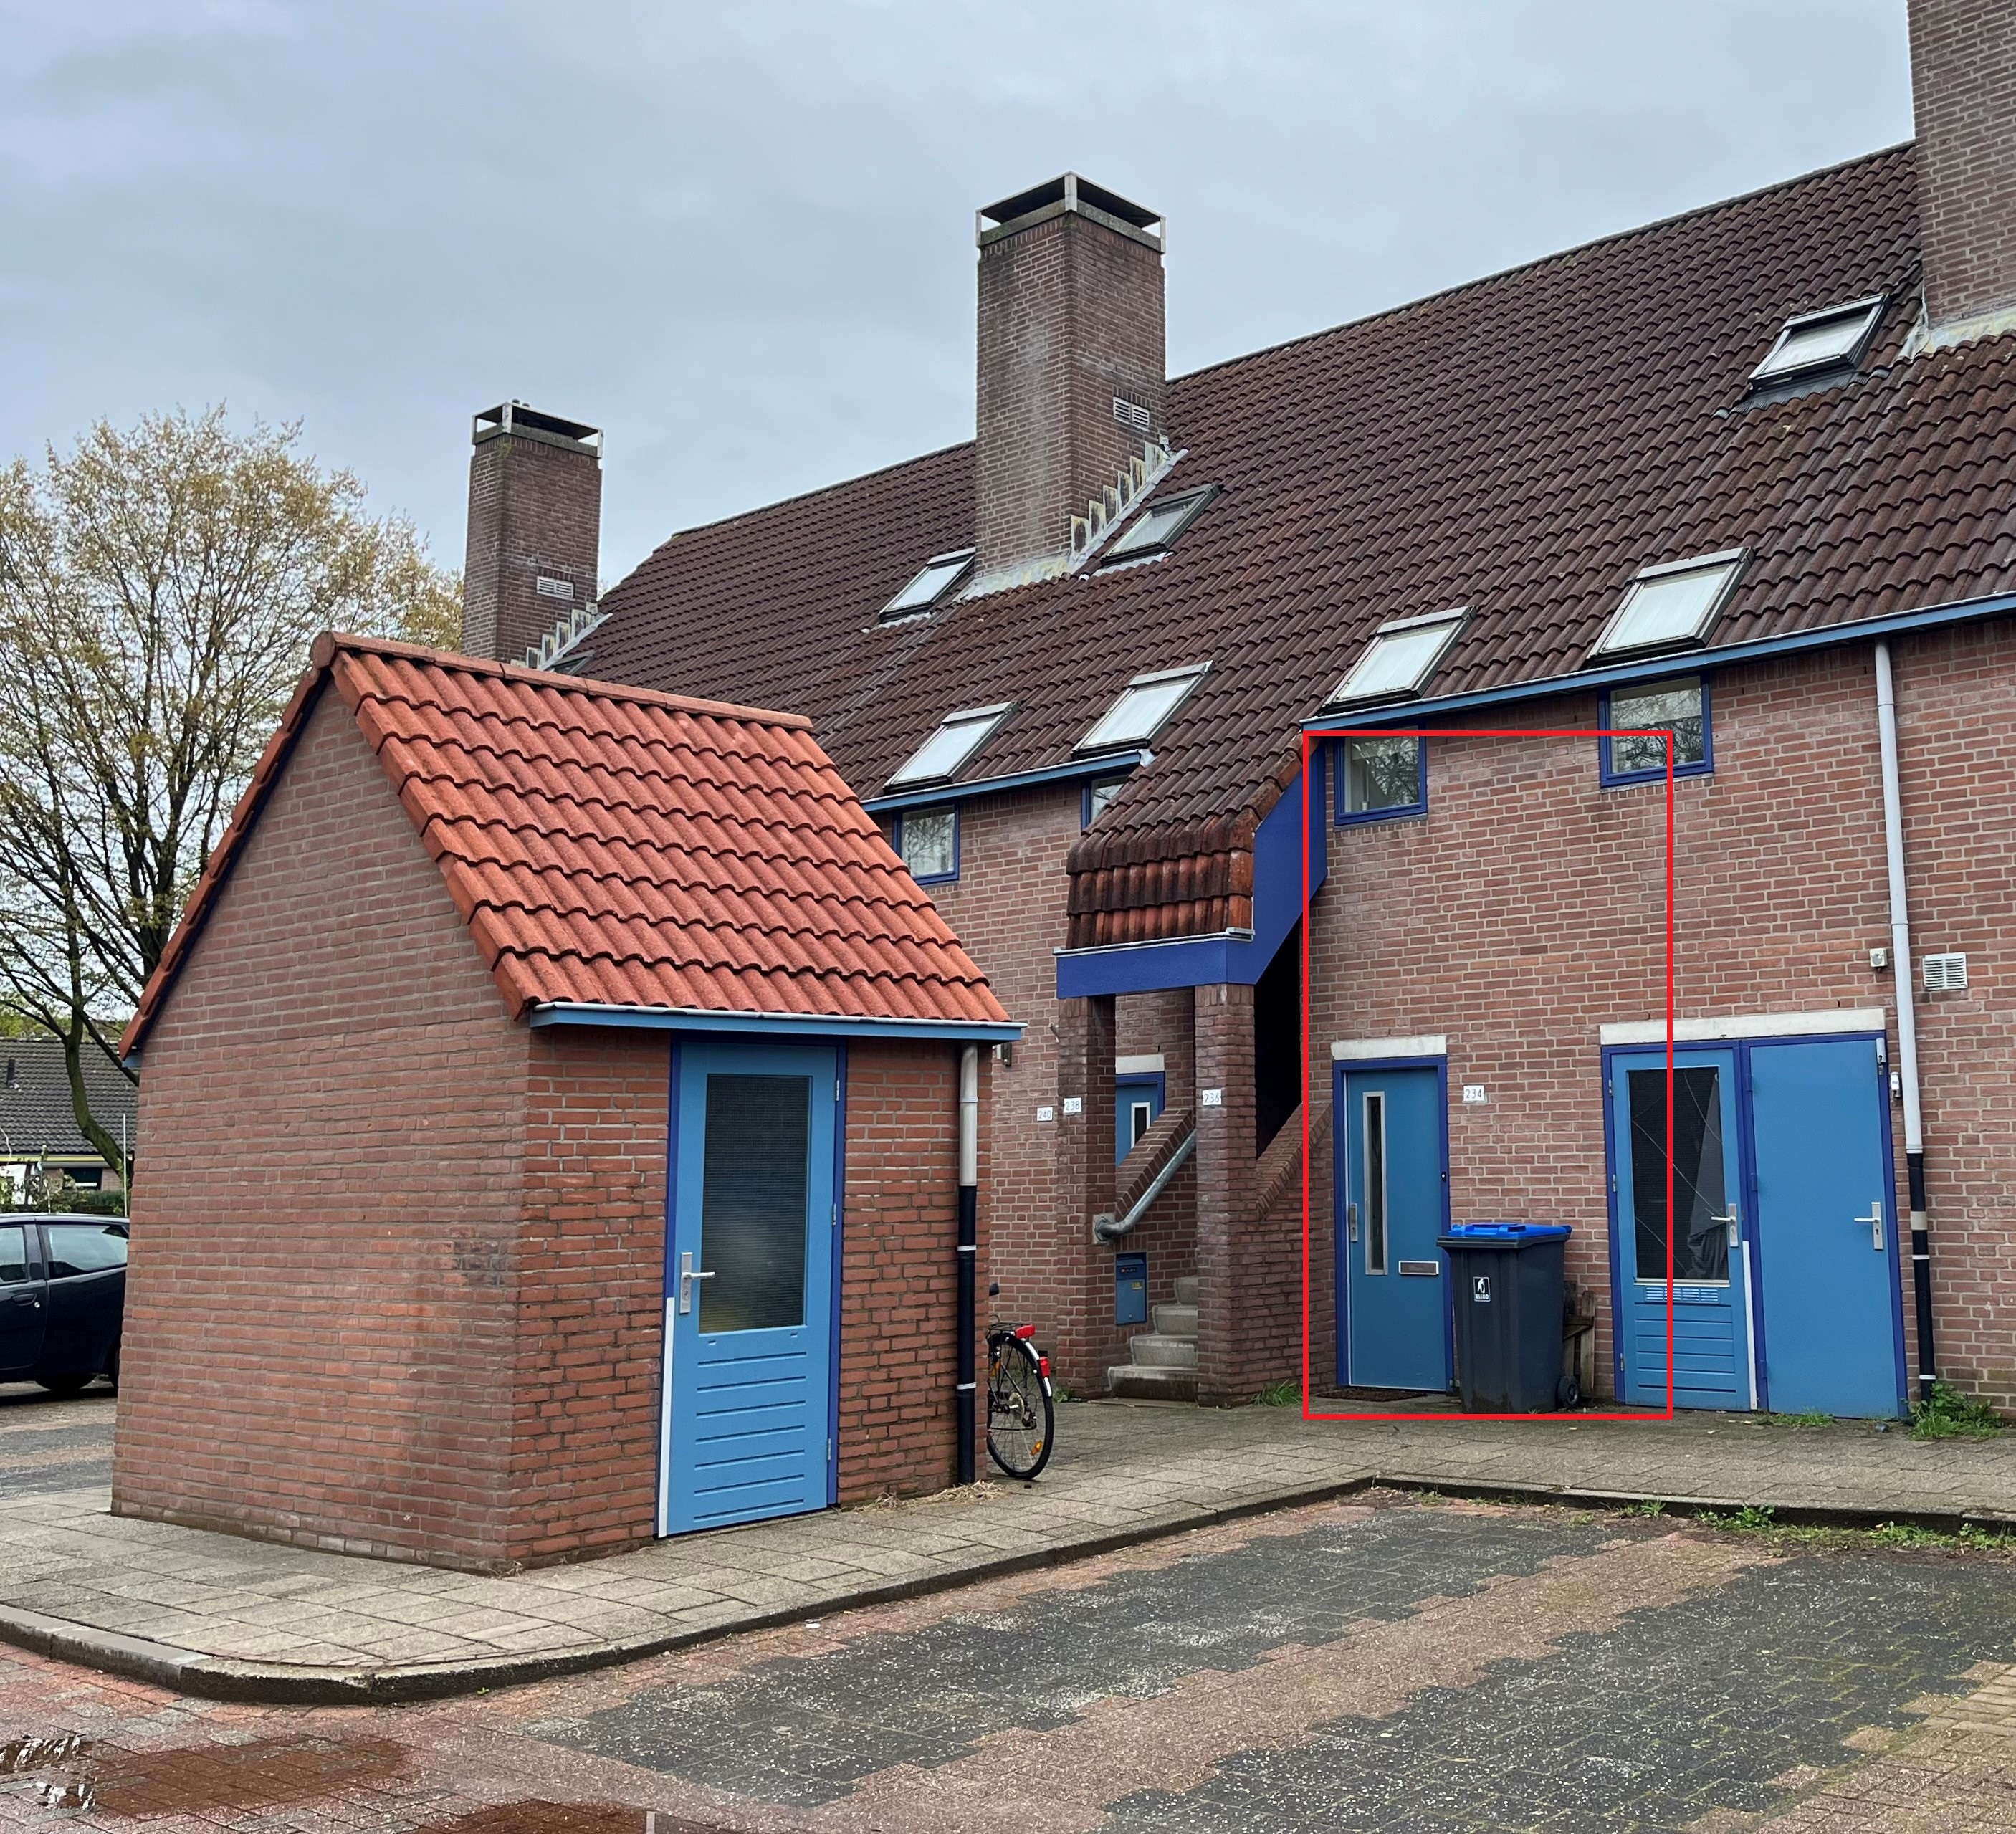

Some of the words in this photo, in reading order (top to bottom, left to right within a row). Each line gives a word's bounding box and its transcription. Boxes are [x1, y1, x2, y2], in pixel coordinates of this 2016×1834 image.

[1204, 1093, 1220, 1103] 236
[1466, 1089, 1482, 1099] 234
[1066, 1101, 1080, 1111] 238
[1038, 1110, 1051, 1119] 240
